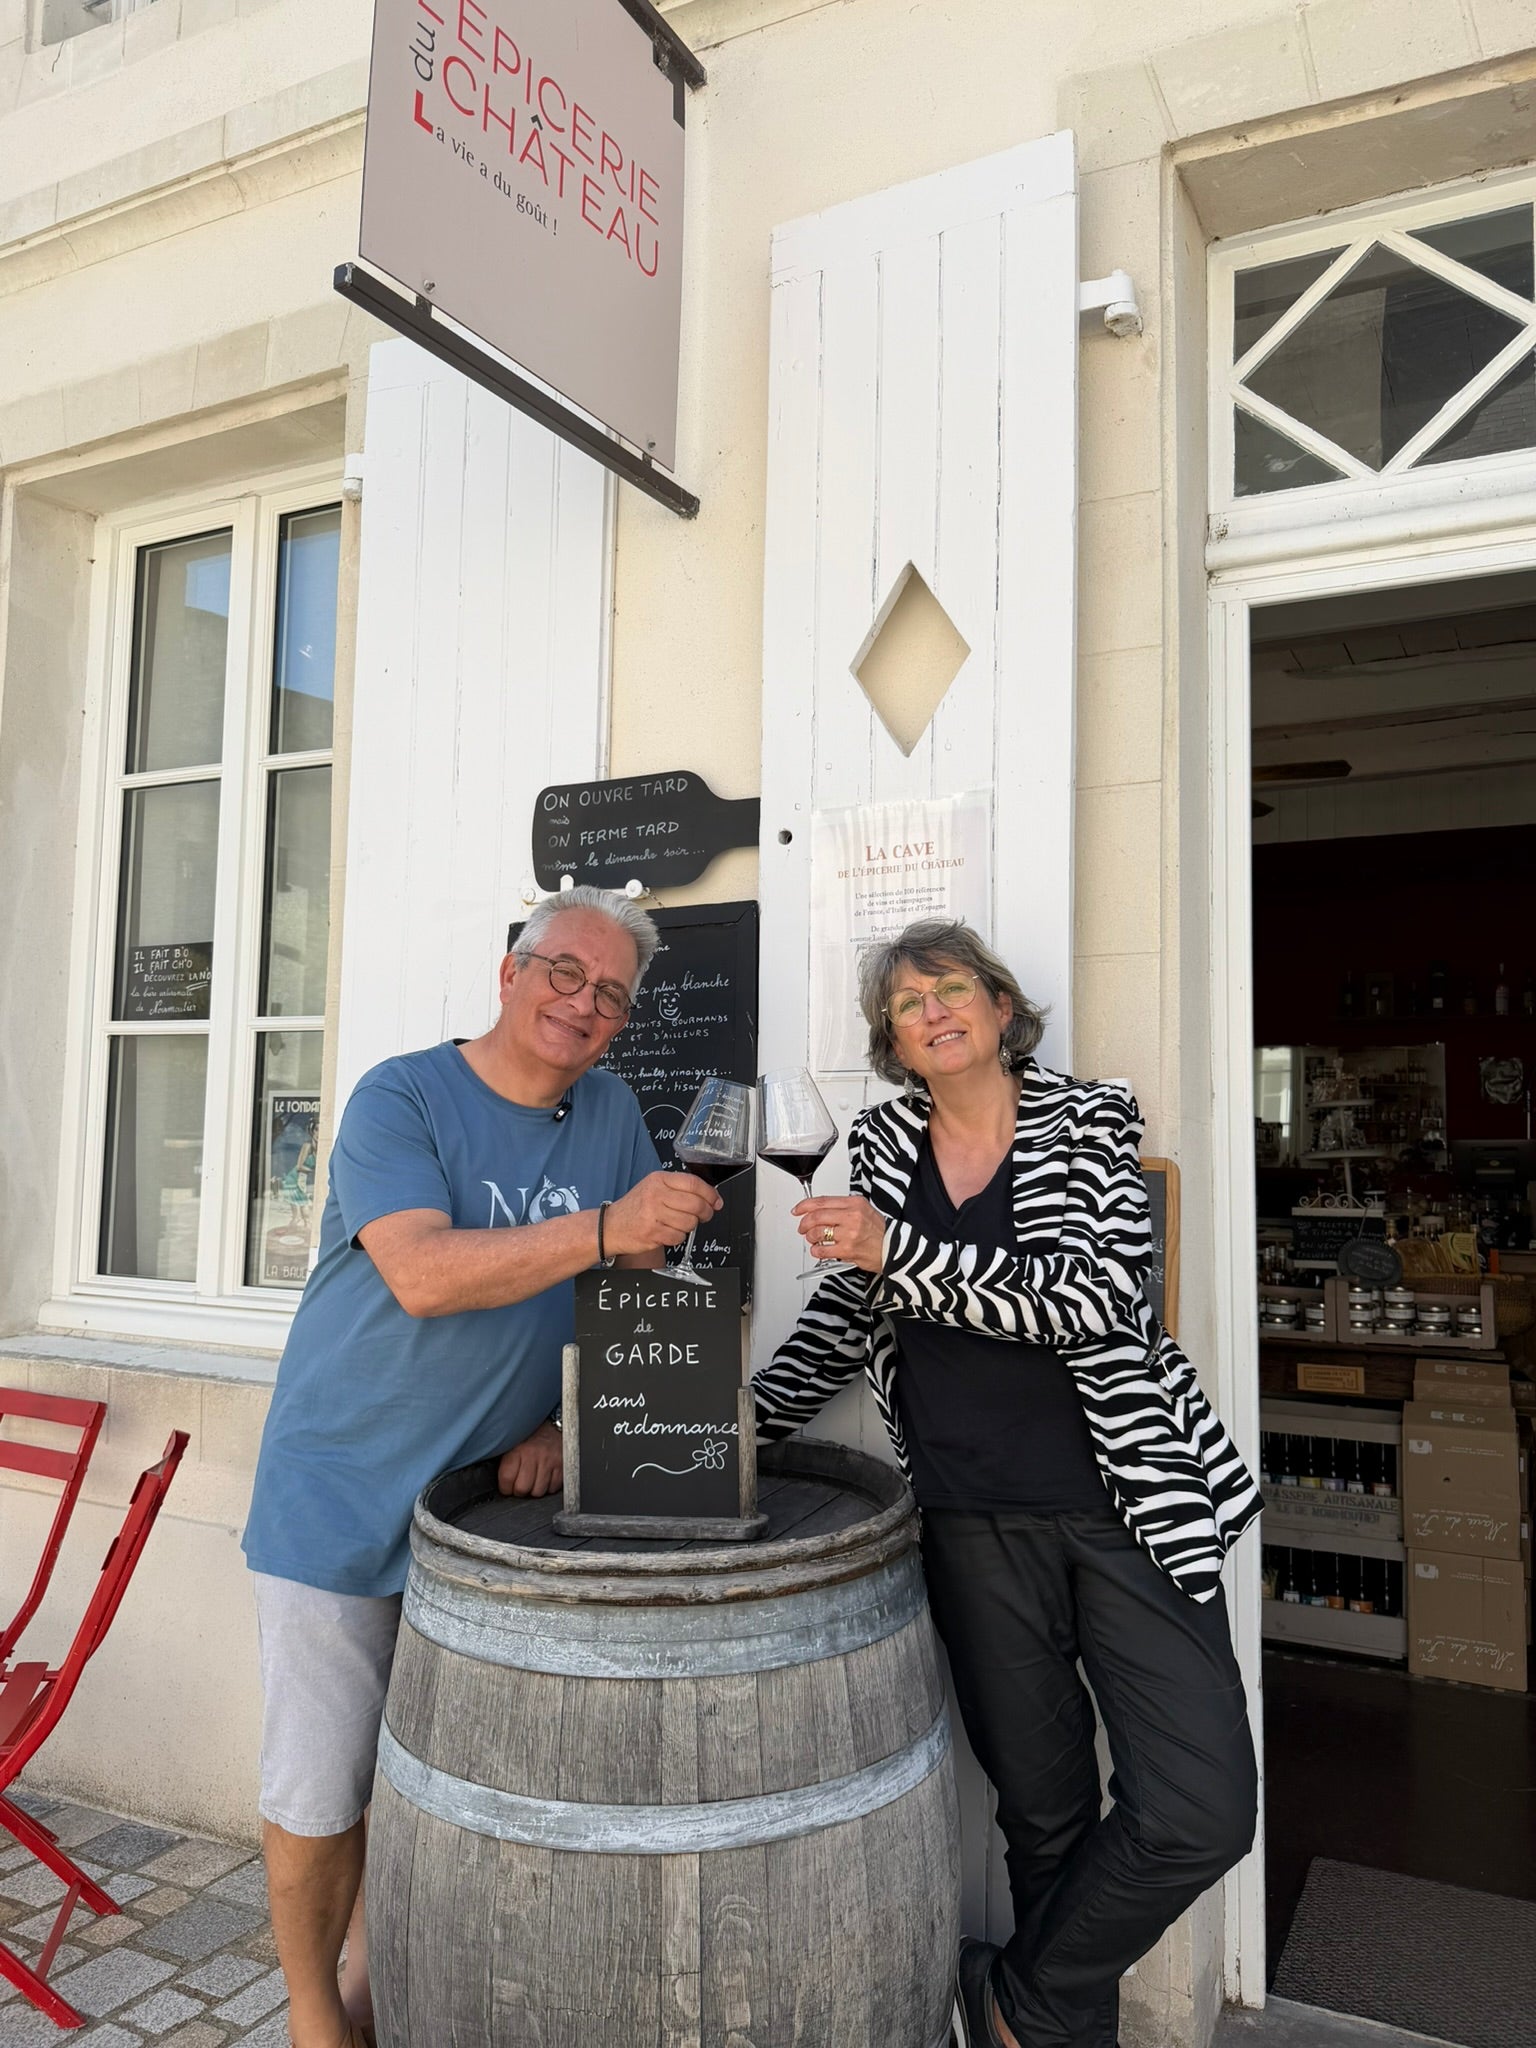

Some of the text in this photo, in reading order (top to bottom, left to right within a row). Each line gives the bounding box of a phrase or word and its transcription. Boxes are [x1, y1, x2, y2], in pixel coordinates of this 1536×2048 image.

[408, 22, 435, 81] du
[442, 55, 660, 277] CHÂTEAU
[451, 137, 475, 168] vie
[479, 164, 489, 179] a
[493, 171, 512, 200] du
[516, 193, 549, 229] goût
[543, 777, 689, 811] ON OUVRE TARD
[549, 816, 570, 825] mais
[549, 821, 680, 848] ON FERME TARD
[542, 861, 578, 872] même
[586, 851, 599, 867] le
[605, 847, 658, 865] dimanche
[134, 951, 145, 960] IL
[151, 947, 170, 959] FAIT
[133, 963, 145, 974] IL
[150, 959, 170, 971] FAIT
[652, 981, 677, 1001] plus
[681, 971, 730, 991] blanche
[630, 1033, 643, 1042] ET
[622, 1044, 677, 1058] artisanales
[674, 1081, 700, 1092] tisan
[655, 1128, 676, 1140] 100
[599, 1279, 717, 1311] ÉPICERIE
[633, 1318, 653, 1334] de
[605, 1343, 700, 1366] GARDE
[593, 1392, 646, 1410] sans
[613, 1413, 740, 1436] ordonnance
